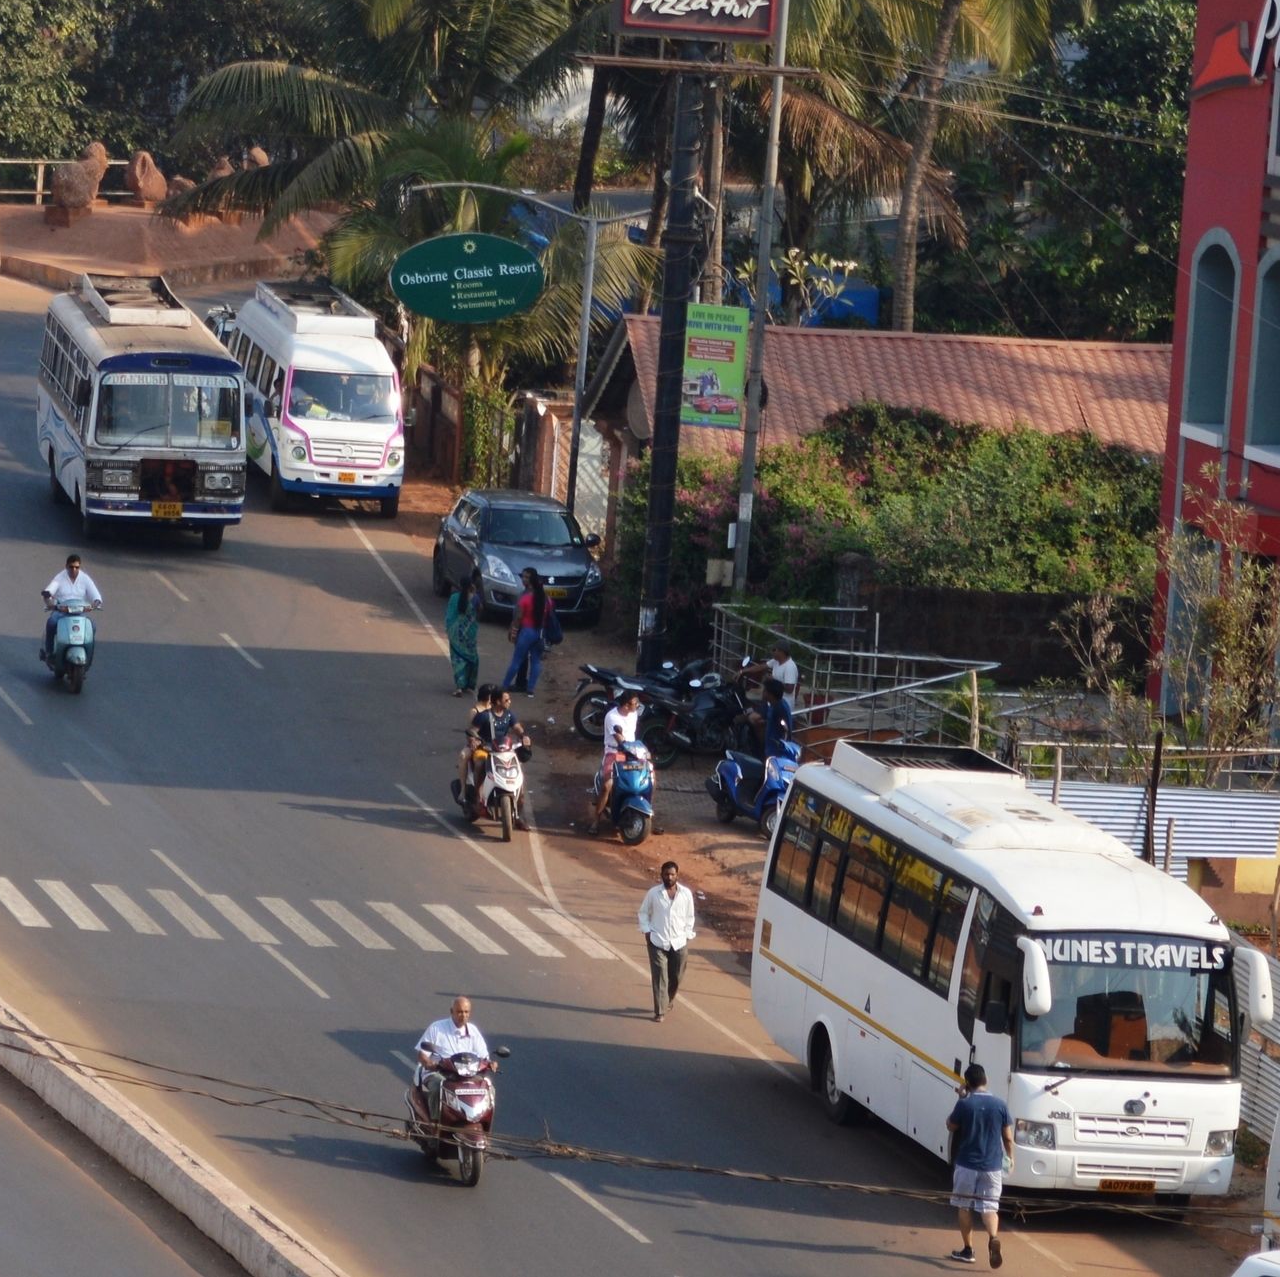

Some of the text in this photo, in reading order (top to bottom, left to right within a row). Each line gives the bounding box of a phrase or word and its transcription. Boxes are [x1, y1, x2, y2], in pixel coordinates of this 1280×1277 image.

[400, 261, 537, 286] Osborne Classic Resort
[456, 281, 483, 289] Rooms
[457, 290, 498, 300] Restaurant
[457, 297, 516, 310] Swimming Pool
[1035, 938, 1226, 970] NUNES TRAVELS
